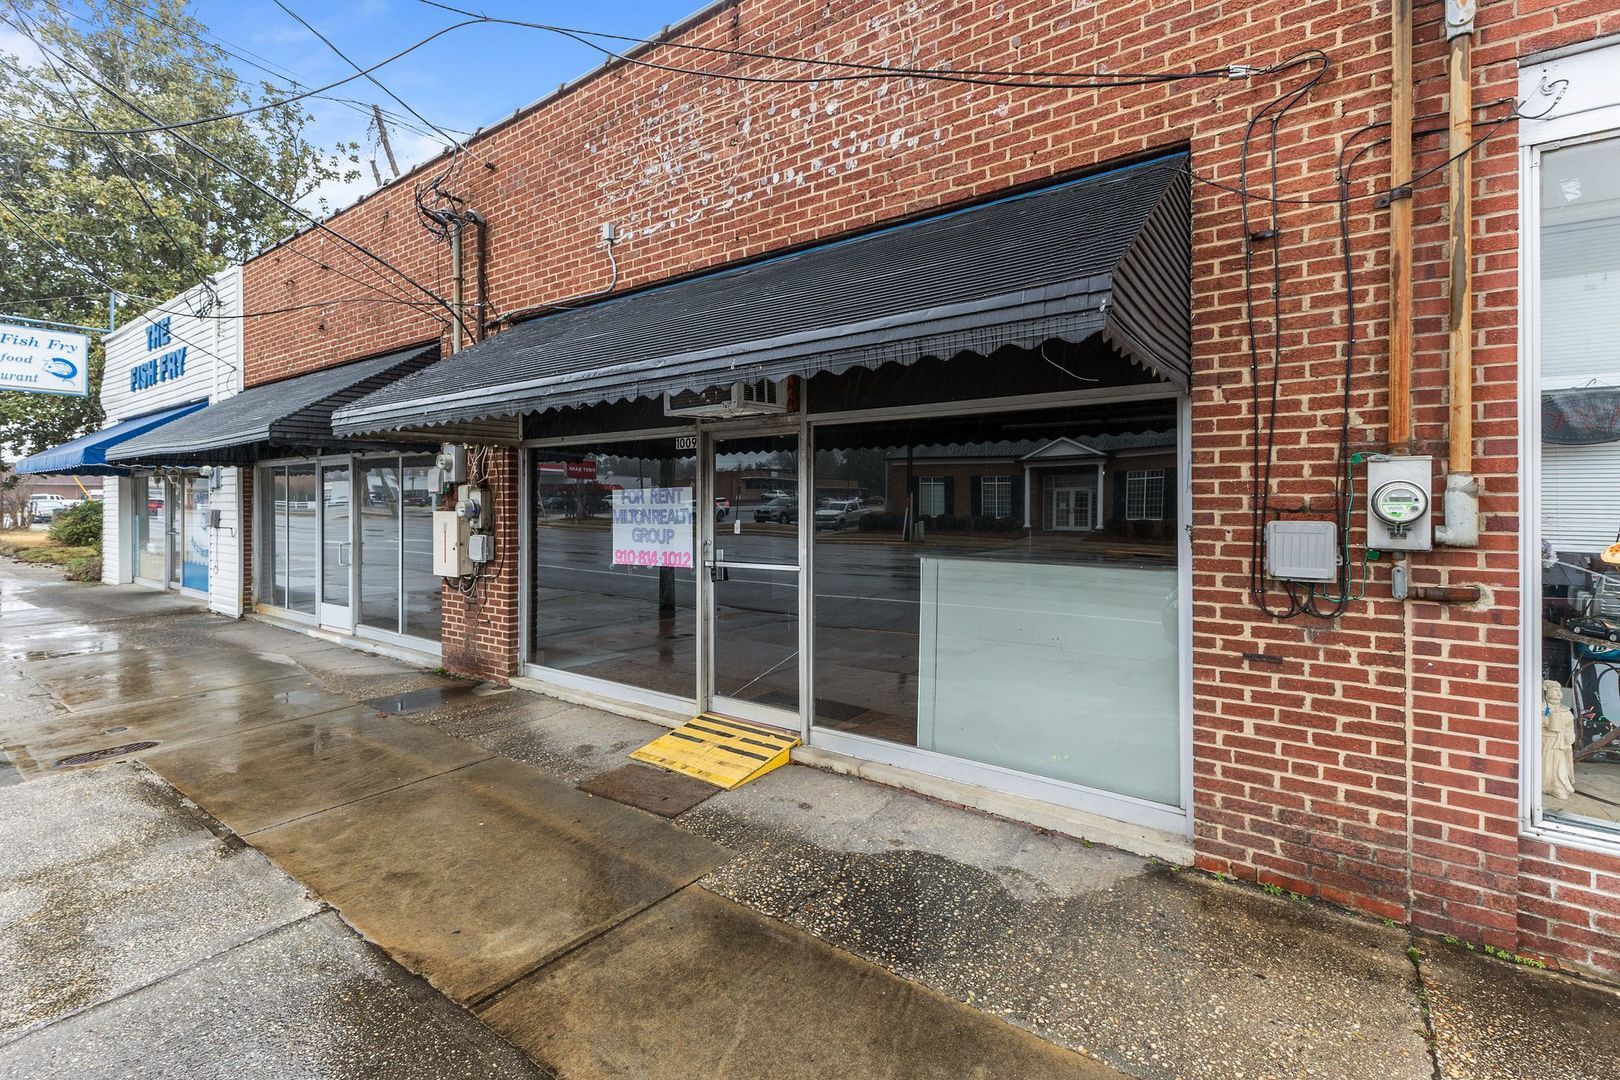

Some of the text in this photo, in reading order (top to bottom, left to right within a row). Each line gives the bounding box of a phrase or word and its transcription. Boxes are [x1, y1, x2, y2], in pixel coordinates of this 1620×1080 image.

[146, 316, 172, 352] THE
[0, 333, 78, 354] Fish Fry
[130, 346, 187, 392] FISH FRY
[676, 437, 696, 449] 1009
[621, 487, 683, 504] FOR RENT
[613, 508, 694, 525] MILTON REALTY
[632, 527, 675, 544] GROUP
[615, 549, 691, 567] 910-814-1012
